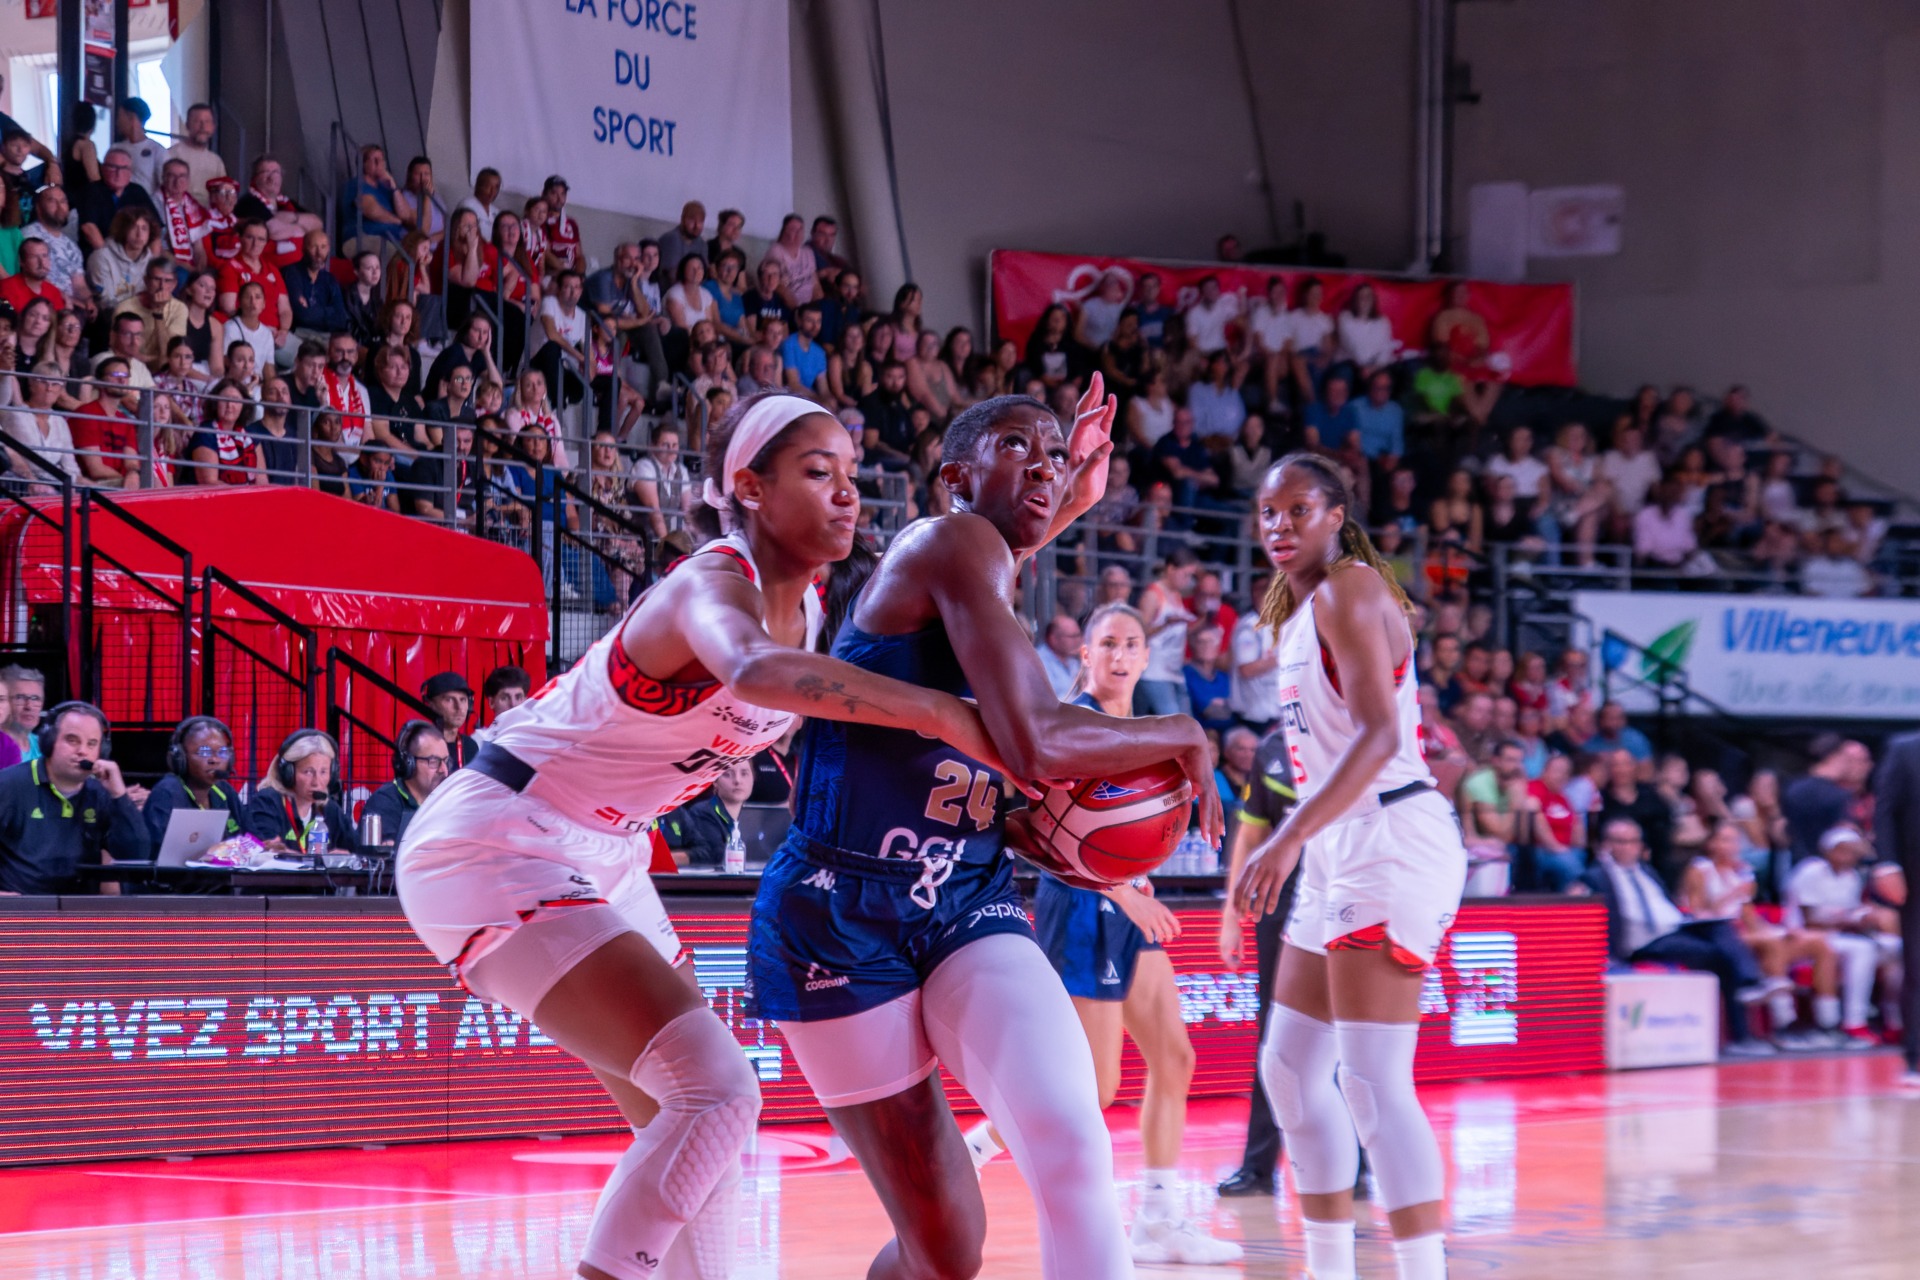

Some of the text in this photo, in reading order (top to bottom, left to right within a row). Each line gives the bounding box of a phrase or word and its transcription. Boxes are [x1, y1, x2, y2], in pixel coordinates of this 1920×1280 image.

[608, 0, 697, 40] FORCE
[615, 49, 649, 90] DU
[593, 105, 677, 156] SPORT
[924, 758, 998, 832] 24
[28, 1000, 229, 1060] VIVEZ
[243, 993, 440, 1057] SPORT
